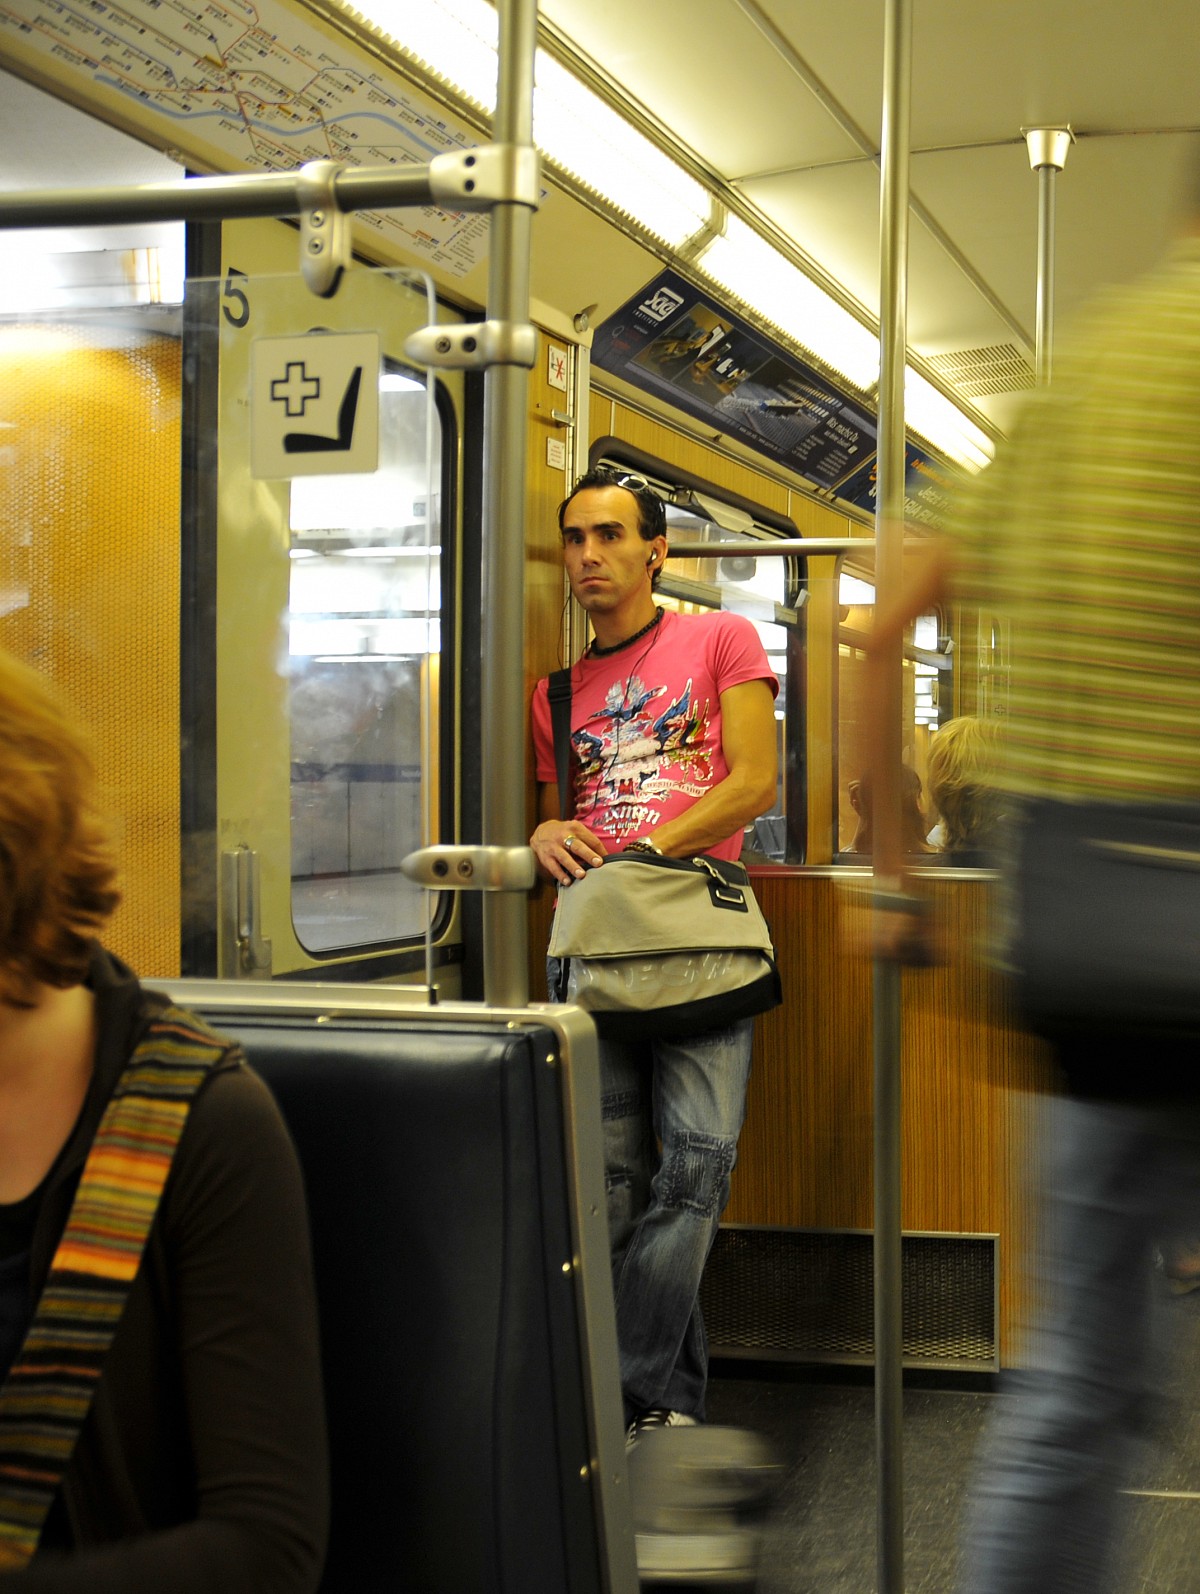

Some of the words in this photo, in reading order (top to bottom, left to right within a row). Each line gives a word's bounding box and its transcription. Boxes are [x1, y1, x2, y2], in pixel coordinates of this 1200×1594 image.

[222, 266, 250, 328] 5
[826, 416, 838, 429] Was
[834, 422, 853, 440] machst
[850, 431, 860, 443] Du
[917, 485, 941, 505] Jetzt
